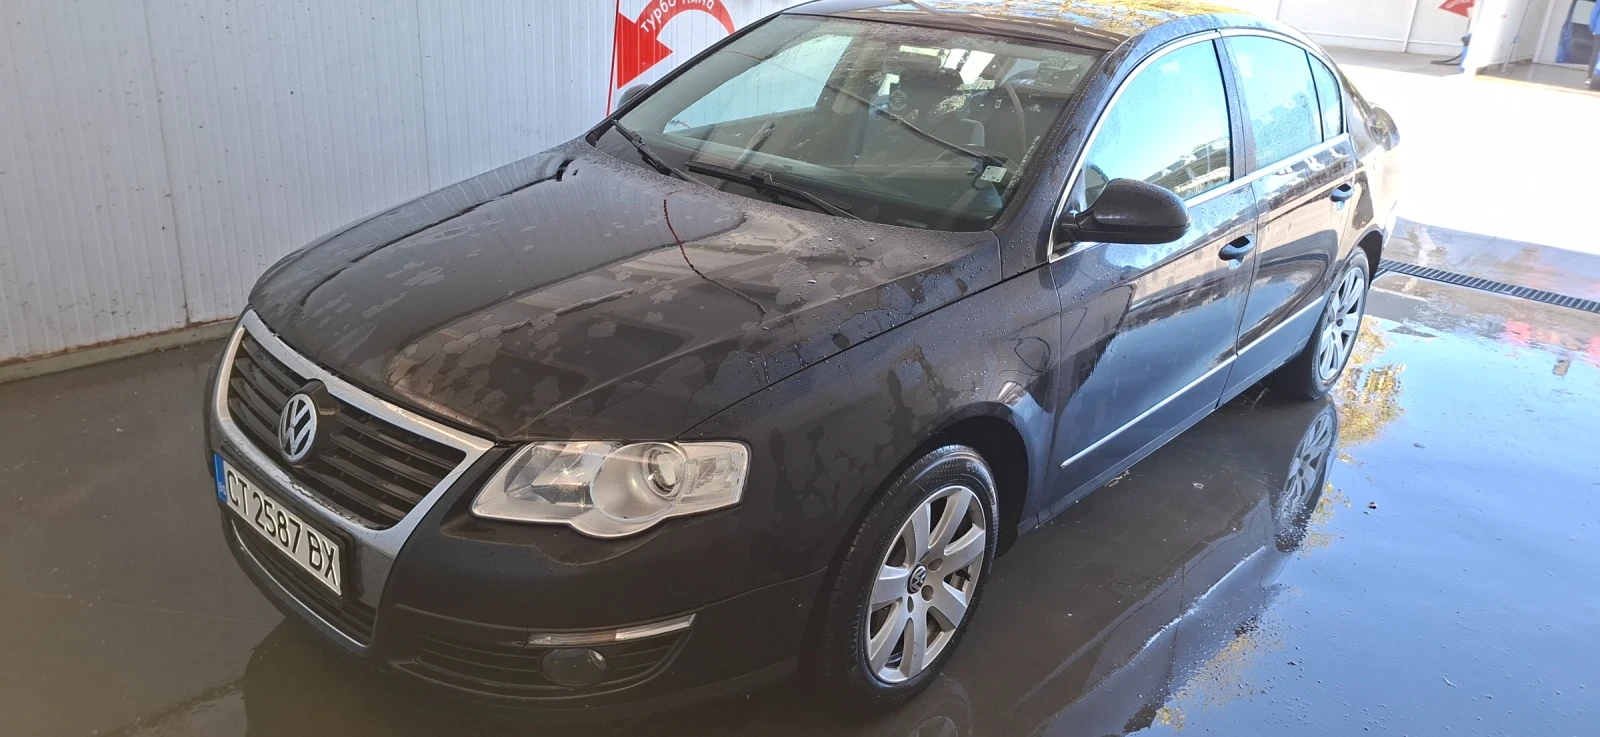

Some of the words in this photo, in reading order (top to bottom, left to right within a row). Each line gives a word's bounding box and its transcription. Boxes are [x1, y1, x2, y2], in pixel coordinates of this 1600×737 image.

[640, 0, 676, 33] турбо
[227, 470, 249, 516] CT
[252, 491, 302, 554] 2587
[306, 530, 338, 586] BX
